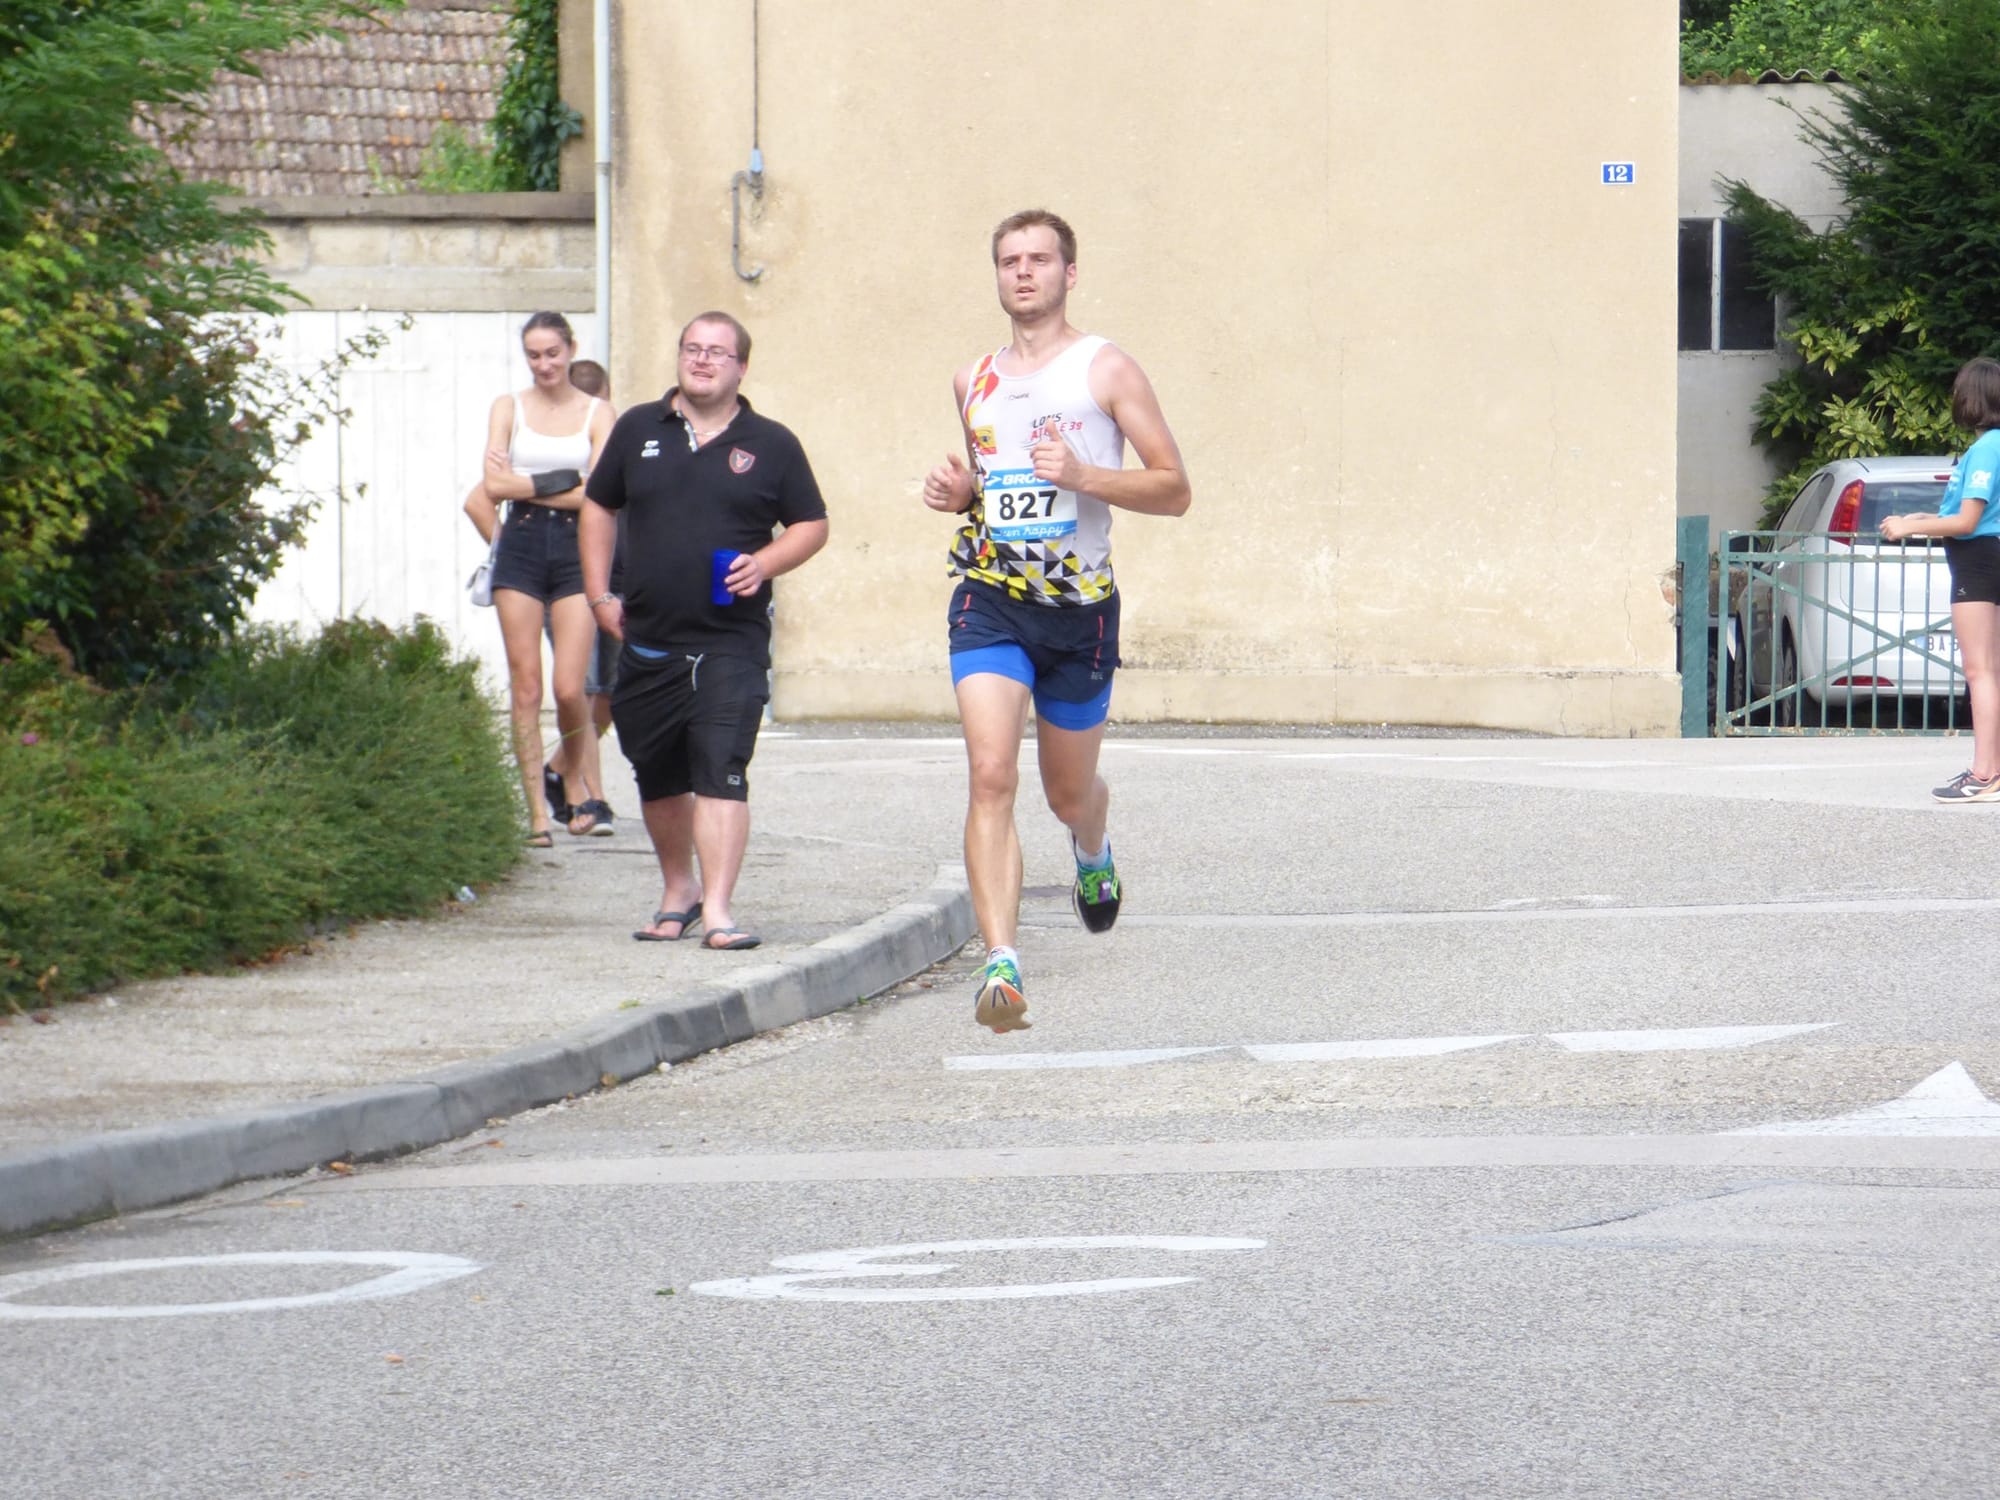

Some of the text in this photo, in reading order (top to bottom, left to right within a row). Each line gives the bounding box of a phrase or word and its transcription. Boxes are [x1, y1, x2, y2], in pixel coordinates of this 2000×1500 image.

[1607, 165, 1628, 182] 12
[999, 490, 1058, 520] 827
[1023, 525, 1064, 537] happy
